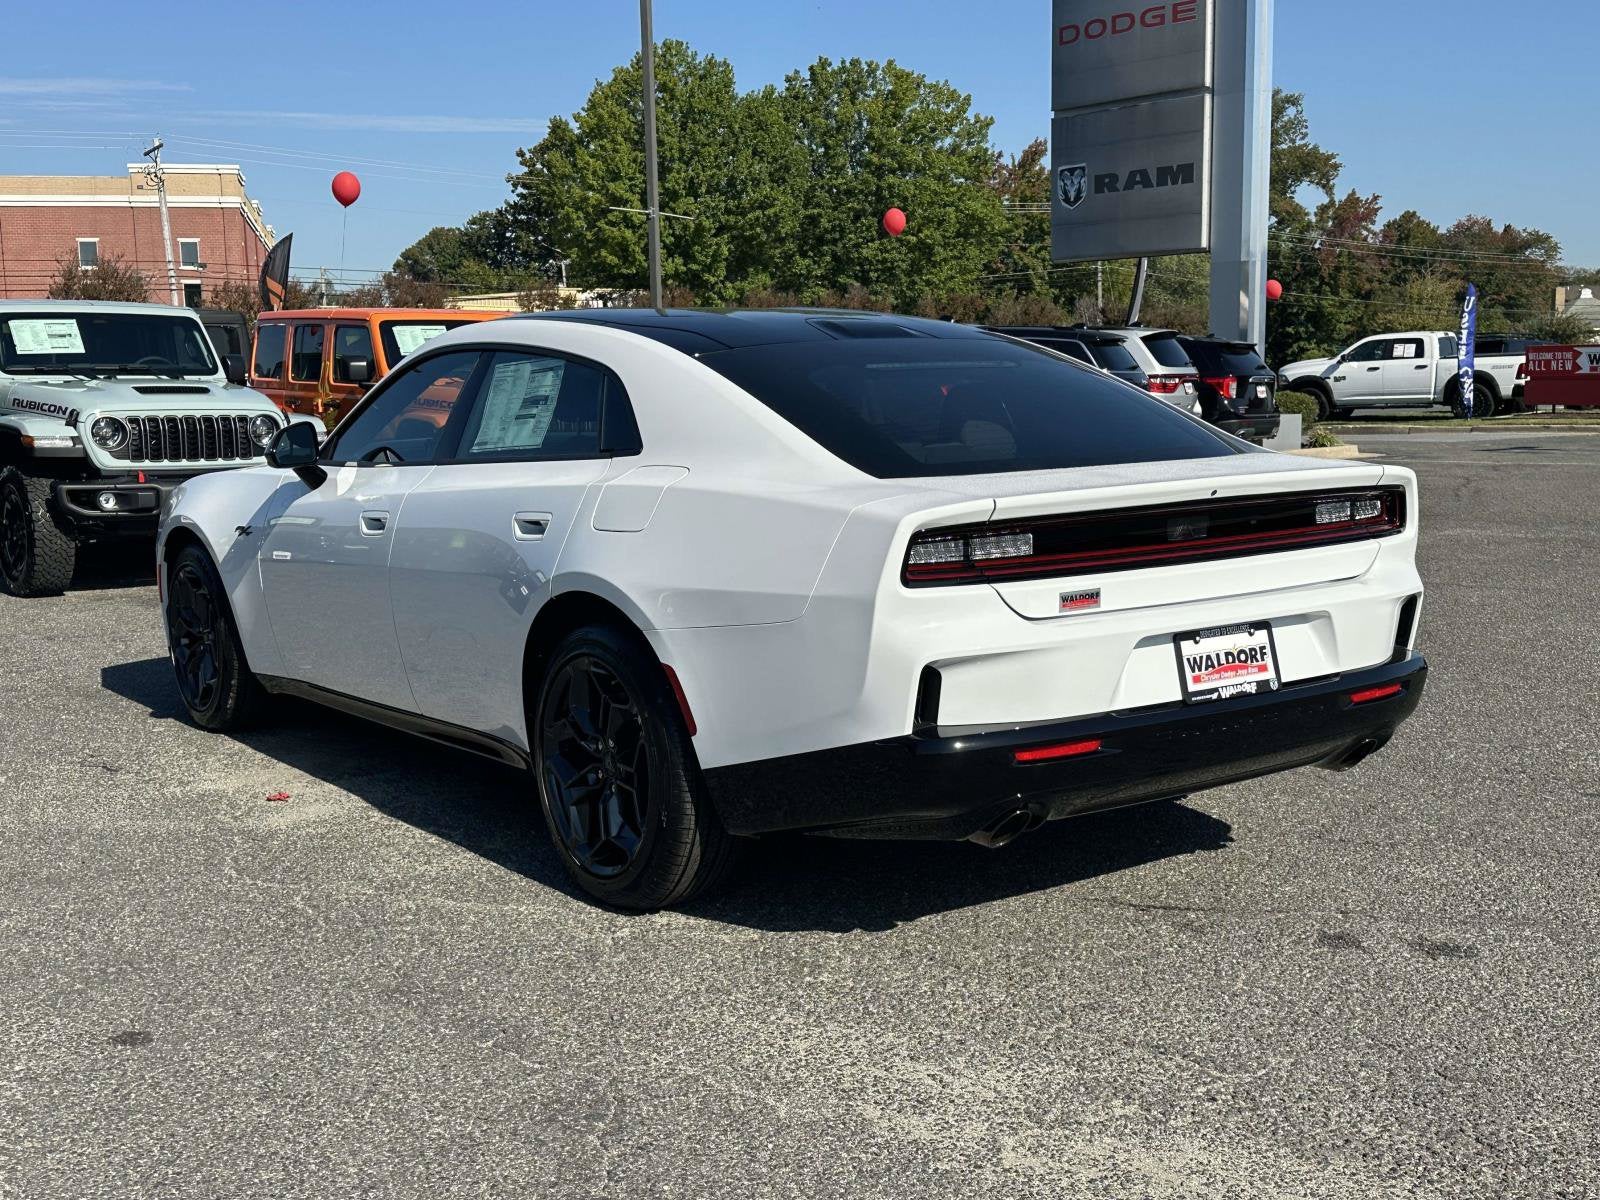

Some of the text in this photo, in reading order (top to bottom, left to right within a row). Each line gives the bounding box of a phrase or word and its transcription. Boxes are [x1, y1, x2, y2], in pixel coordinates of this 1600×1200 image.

[1058, 0, 1197, 46] DODGE
[1094, 162, 1194, 194] RAM
[1529, 352, 1573, 360] WELCOME TO THE
[1529, 361, 1573, 371] ALL NEW
[12, 398, 69, 416] RUBICON
[1061, 592, 1100, 603] WALDORF
[1186, 645, 1267, 674] WALDORF
